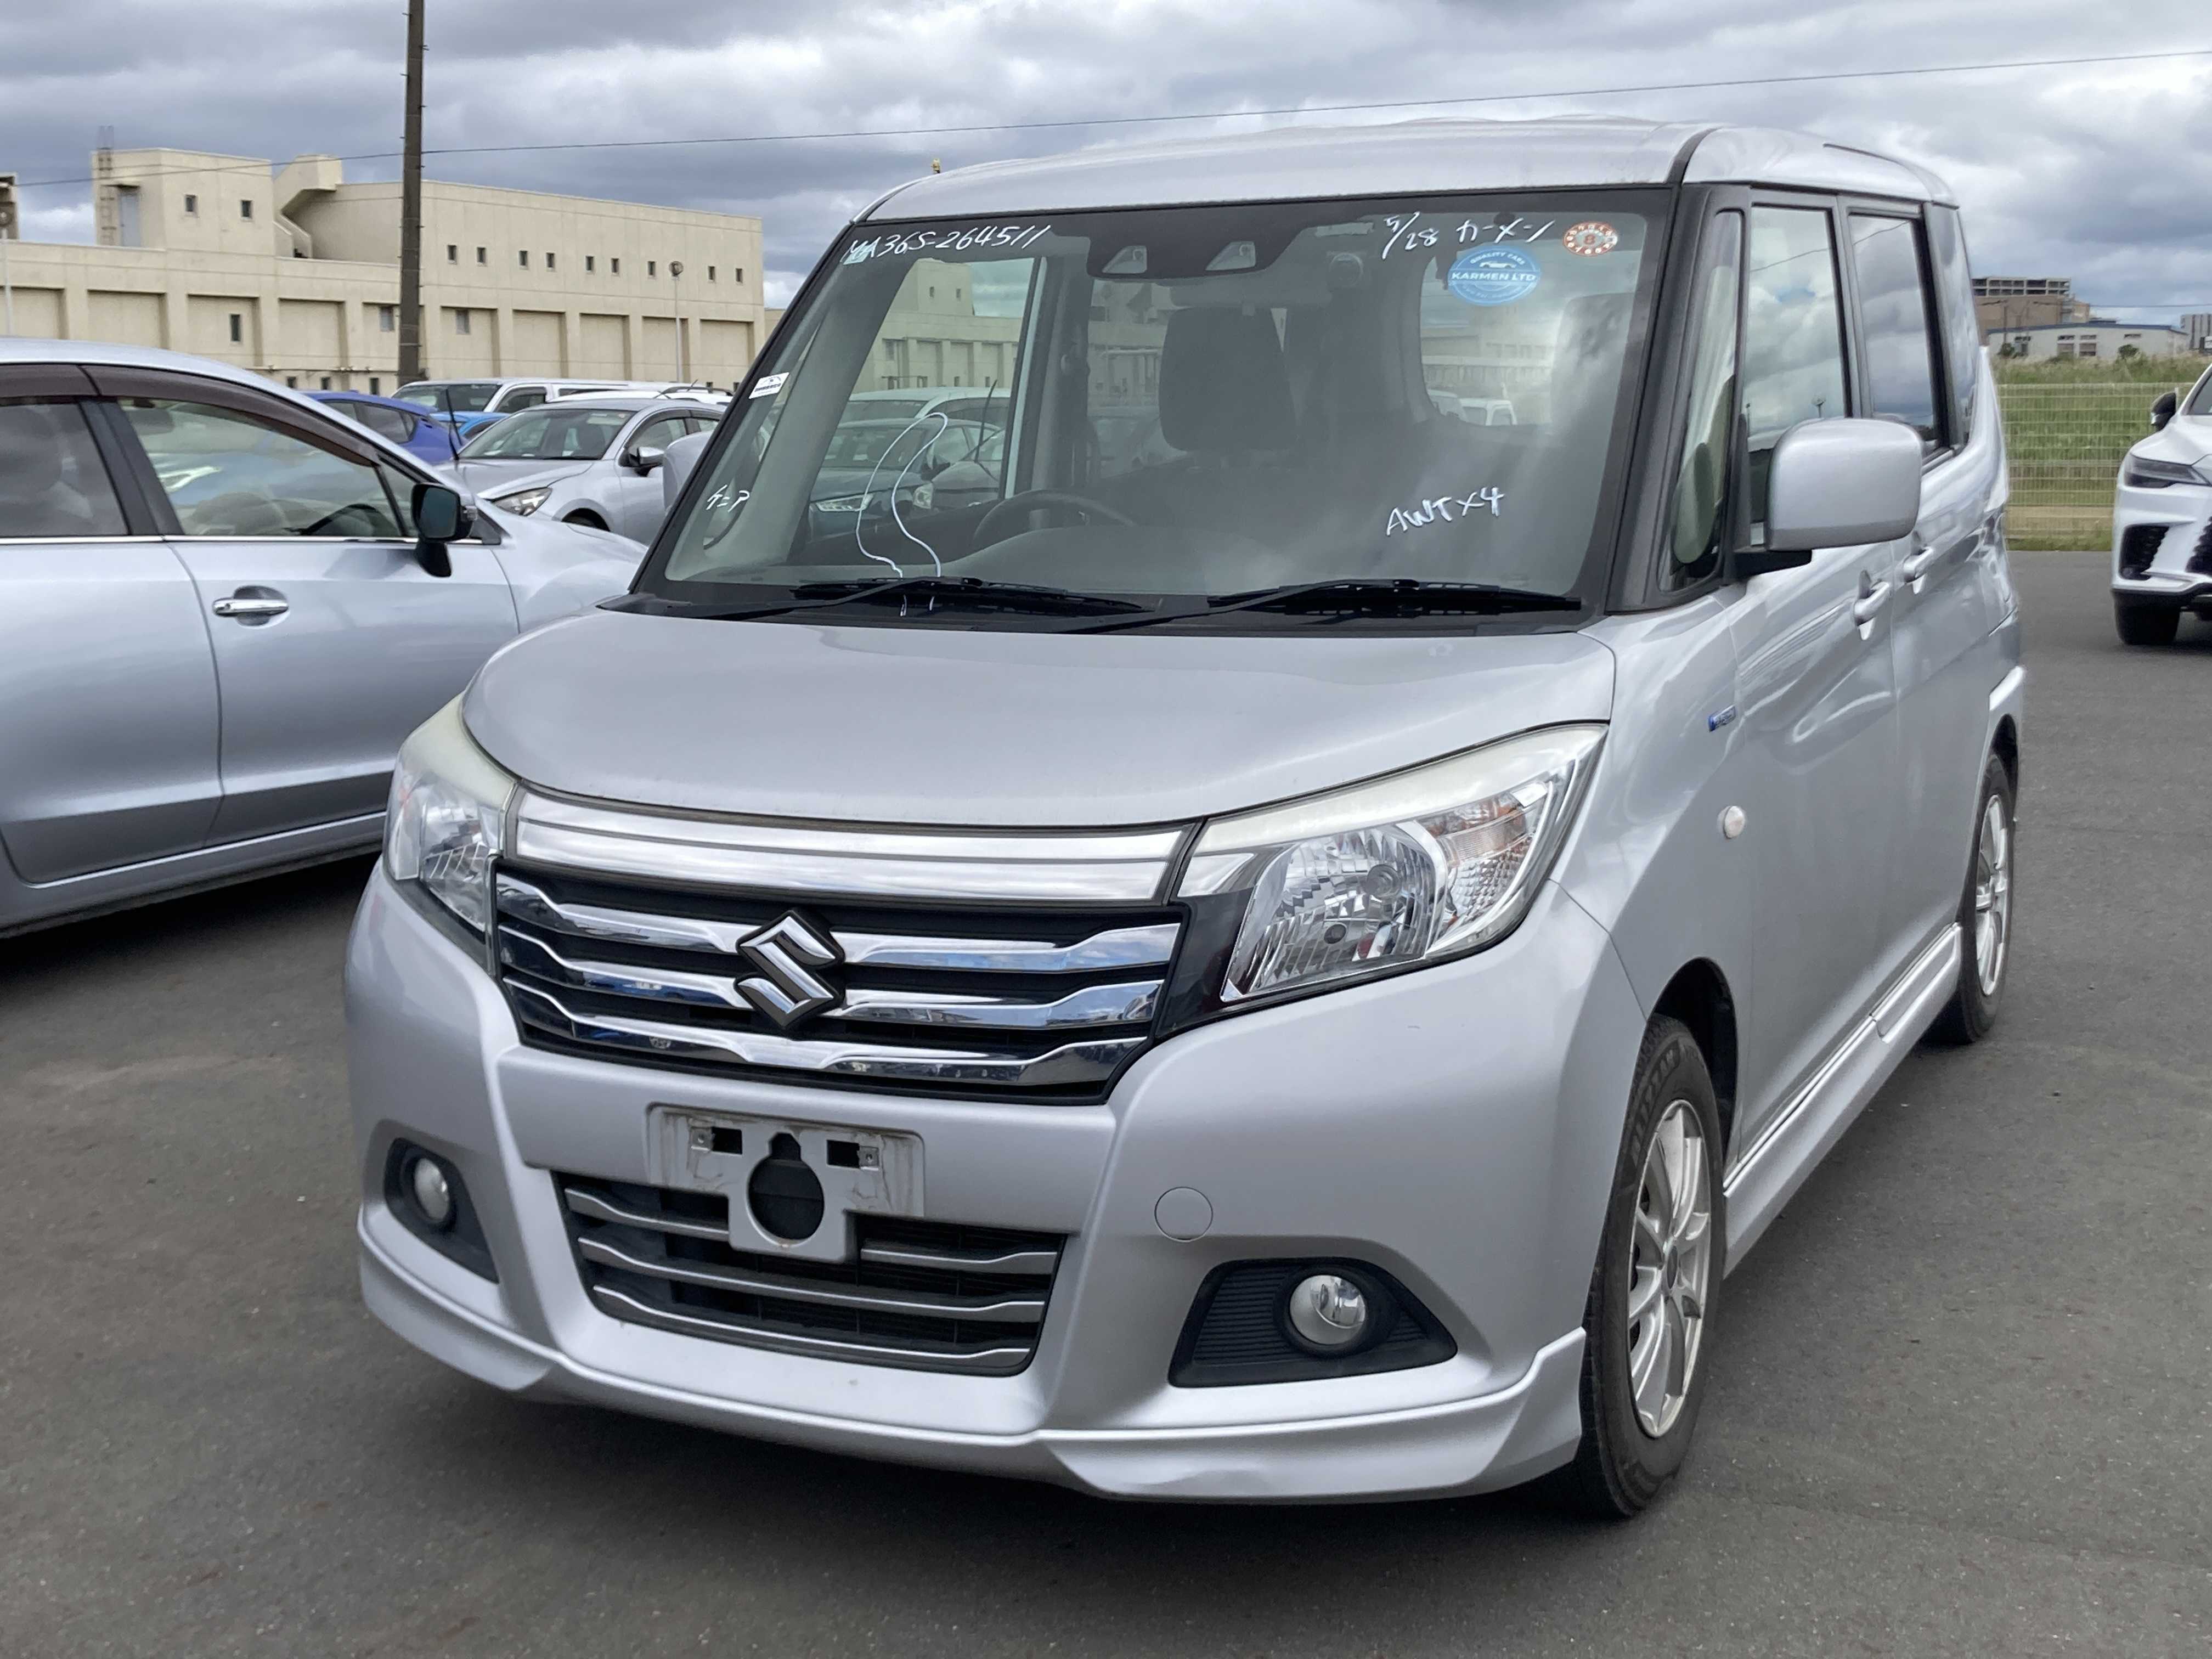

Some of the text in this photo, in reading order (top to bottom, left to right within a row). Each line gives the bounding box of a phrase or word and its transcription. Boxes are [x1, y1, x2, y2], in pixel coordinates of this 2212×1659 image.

[1470, 251, 1526, 265] QUALITY CARS
[1451, 272, 1537, 281] KARMEN LTD
